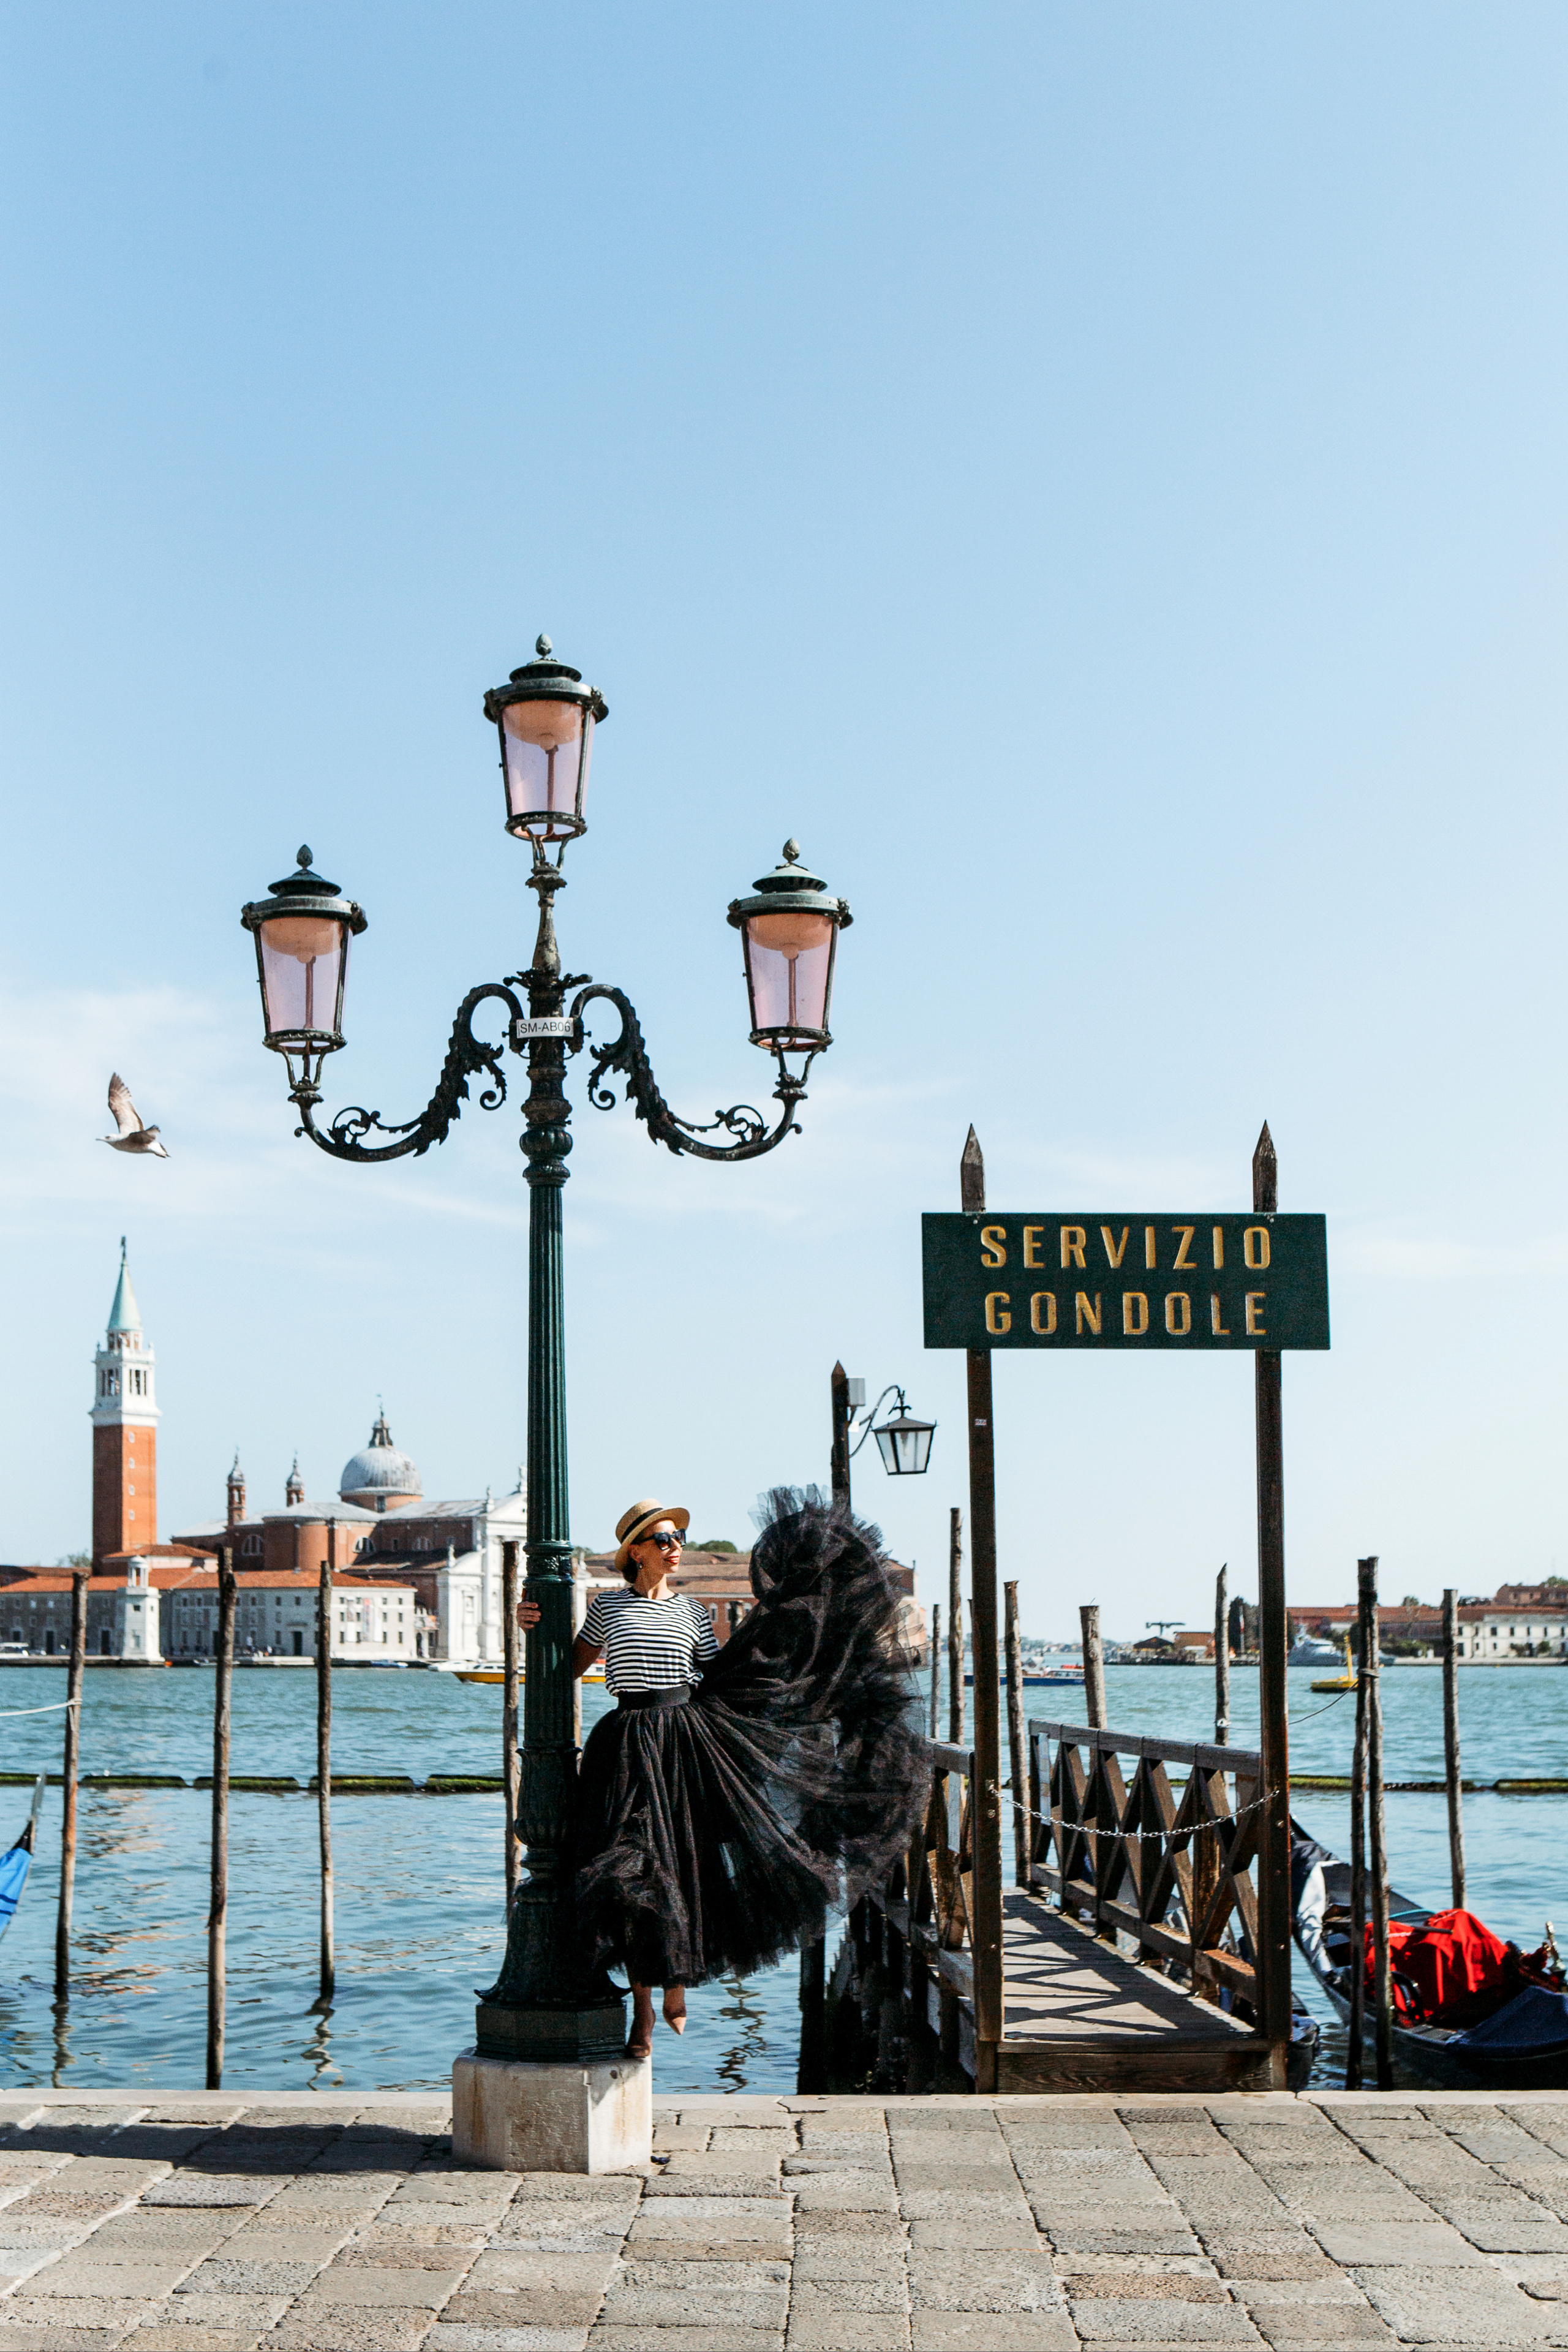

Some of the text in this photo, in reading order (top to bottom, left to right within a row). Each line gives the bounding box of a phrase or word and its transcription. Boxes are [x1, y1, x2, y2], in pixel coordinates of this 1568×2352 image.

[520, 1022, 571, 1033] SM-AB06
[980, 1226, 1272, 1269] SERVIZIO
[984, 1291, 1267, 1335] GONDOLE
